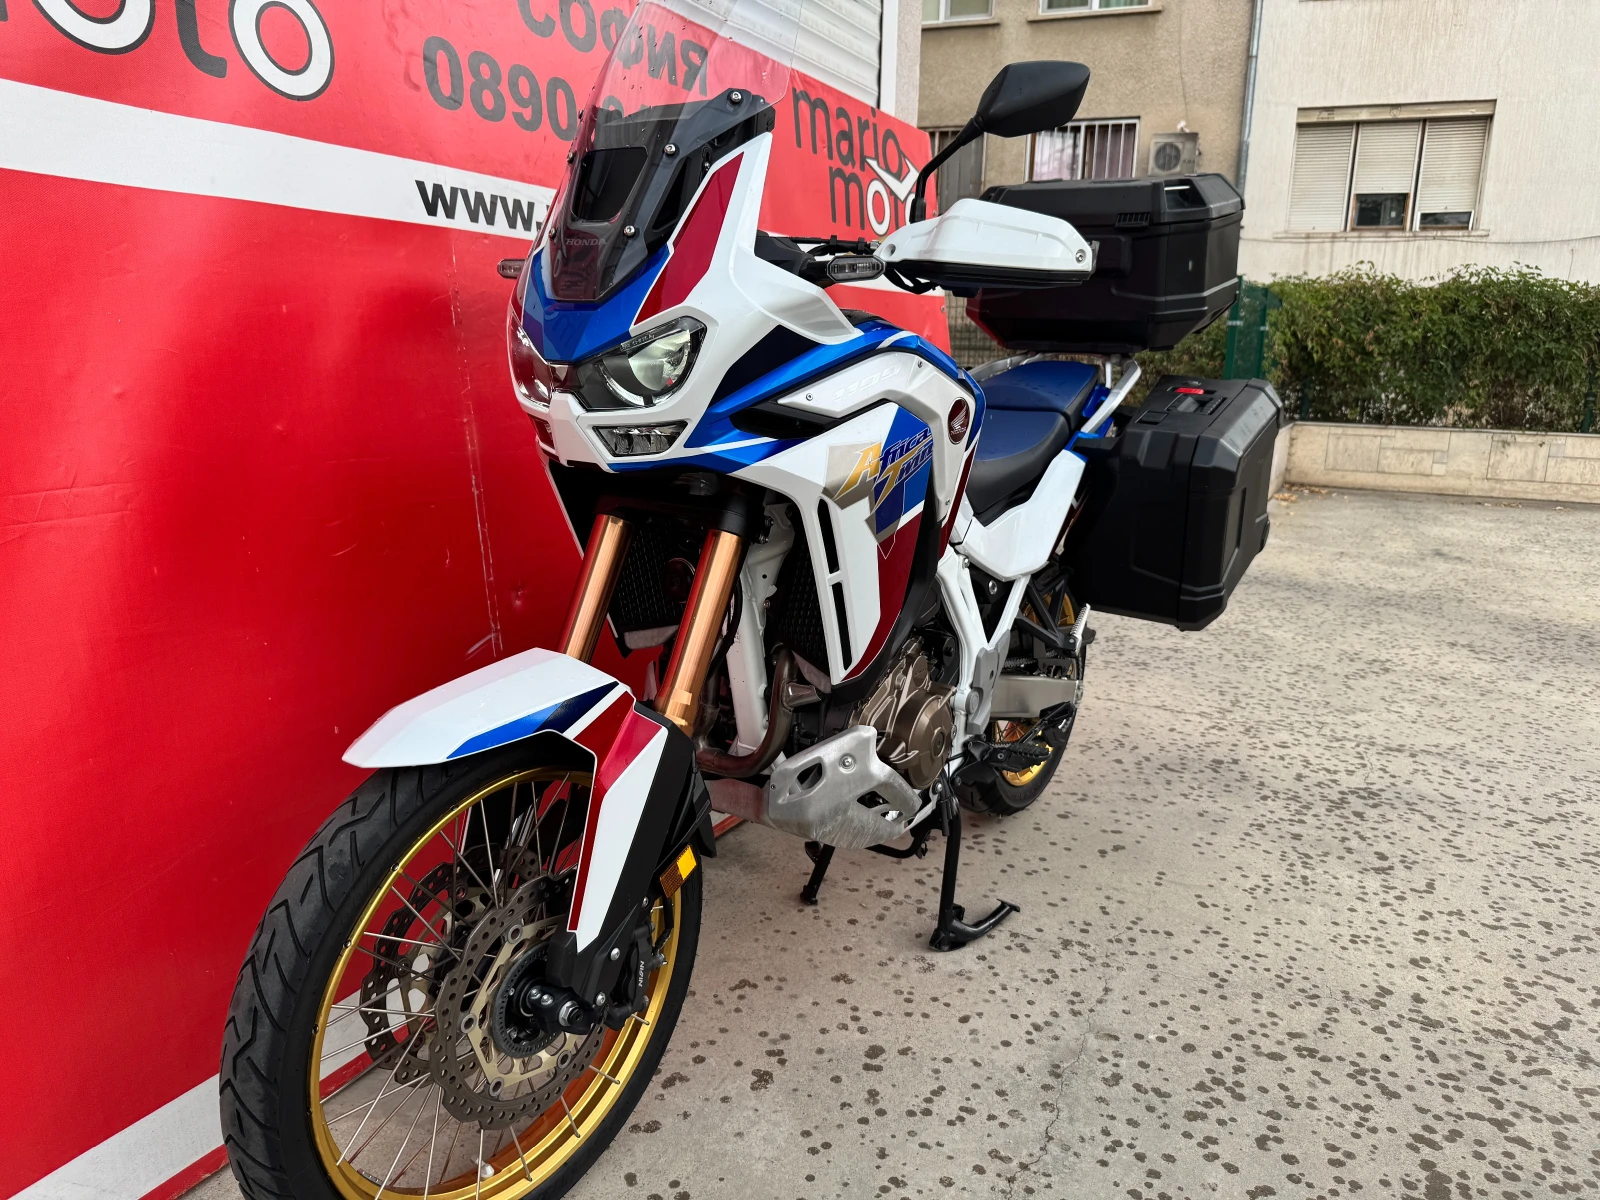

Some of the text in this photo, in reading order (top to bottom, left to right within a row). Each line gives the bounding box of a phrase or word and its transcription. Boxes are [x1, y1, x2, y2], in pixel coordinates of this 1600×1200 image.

[422, 35, 577, 142] 0890
[792, 87, 903, 176] mario
[415, 179, 550, 233] www.
[565, 237, 607, 247] HONDA
